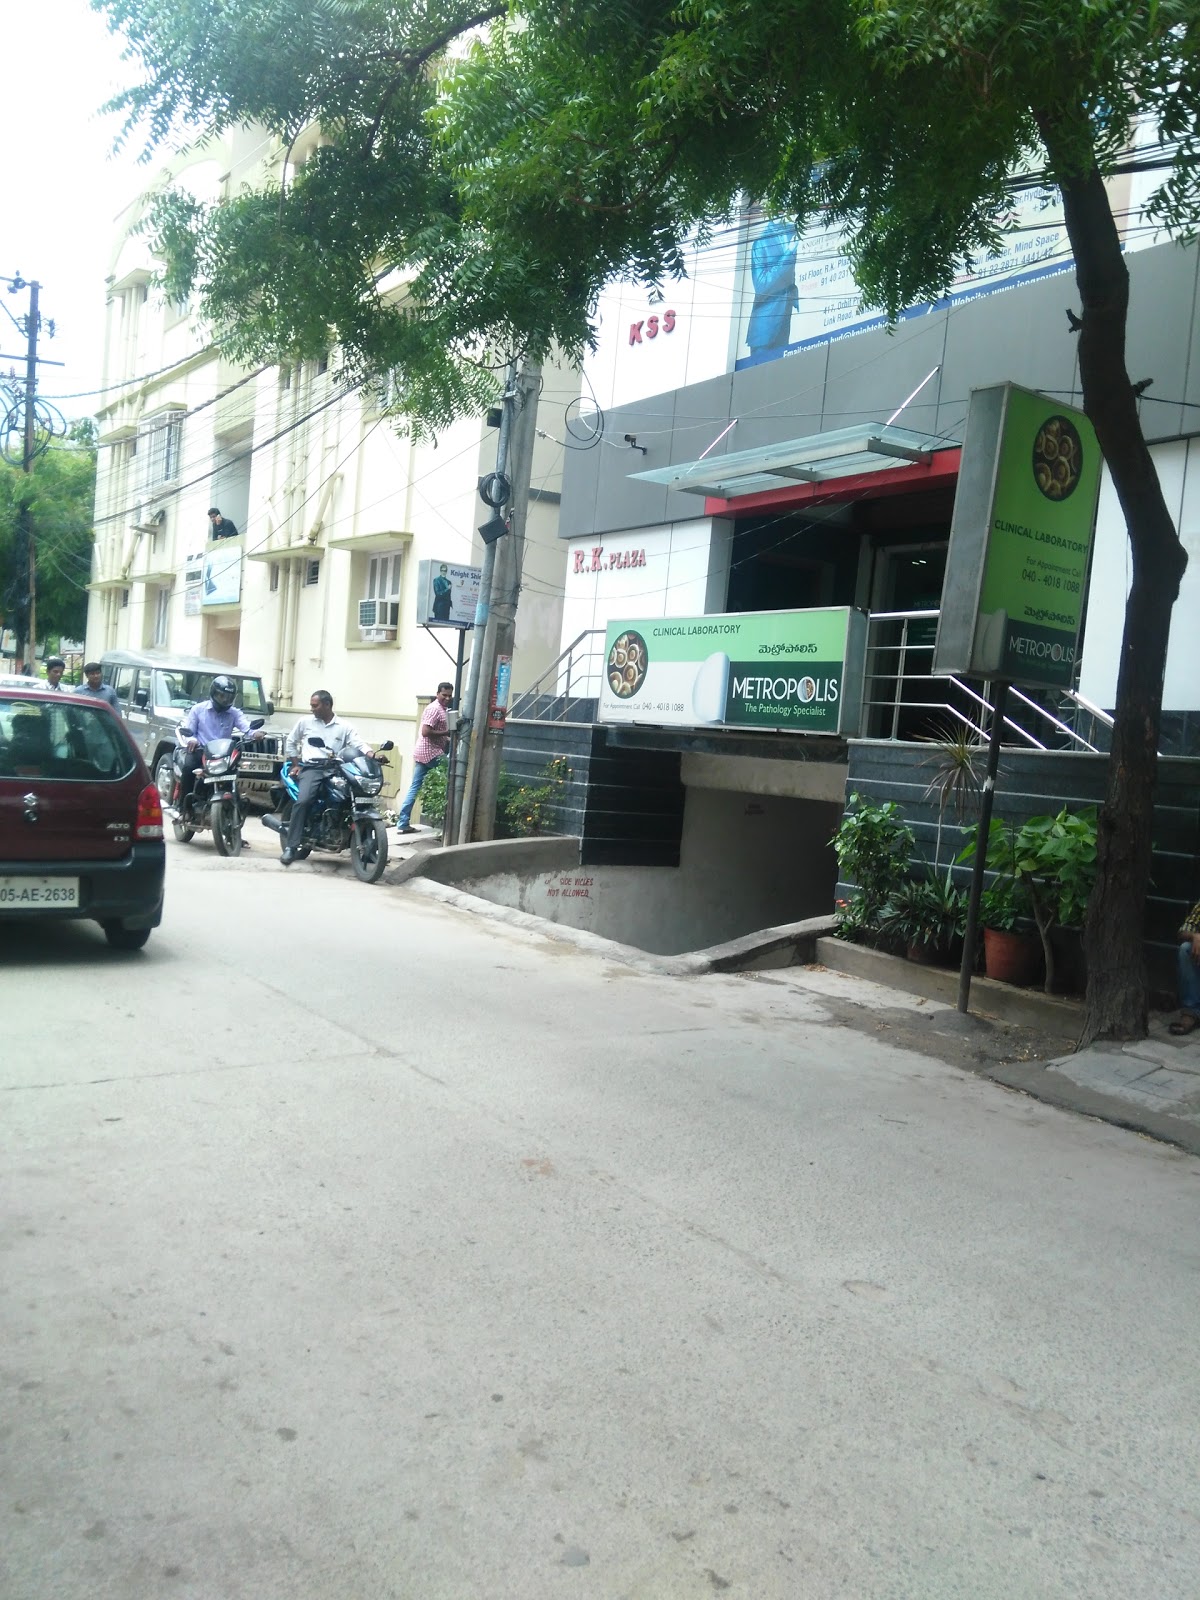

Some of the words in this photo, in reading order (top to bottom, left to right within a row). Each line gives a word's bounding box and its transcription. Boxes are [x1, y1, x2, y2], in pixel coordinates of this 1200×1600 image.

[1014, 240, 1034, 253] Mind
[1035, 232, 1060, 248] Space
[629, 309, 677, 346] KSS
[823, 316, 835, 327] Link
[994, 519, 1033, 539] CLINICAL
[1035, 531, 1089, 553] LABORATORY
[609, 548, 647, 570] PLAZA
[1026, 555, 1037, 565] For
[1037, 560, 1071, 574] Appointment
[450, 569, 470, 579] Knight
[1022, 568, 1037, 582] 040
[1043, 574, 1061, 589] 4018
[1064, 579, 1081, 594] 1088
[652, 625, 686, 637] CLINICAL
[687, 624, 741, 636] LABORATORY
[1009, 635, 1075, 663] METROPOLIS
[732, 675, 838, 704] METROPOLIS
[610, 703, 633, 711] Appointment
[642, 702, 652, 711] 040
[656, 702, 670, 711] 4018
[671, 703, 685, 712] 1088
[744, 702, 757, 713] The
[758, 703, 791, 717] Pathology
[793, 705, 826, 717] Specialist
[560, 877, 573, 886] SIDE
[547, 888, 560, 897] NOT
[561, 888, 590, 898] ALLOWED
